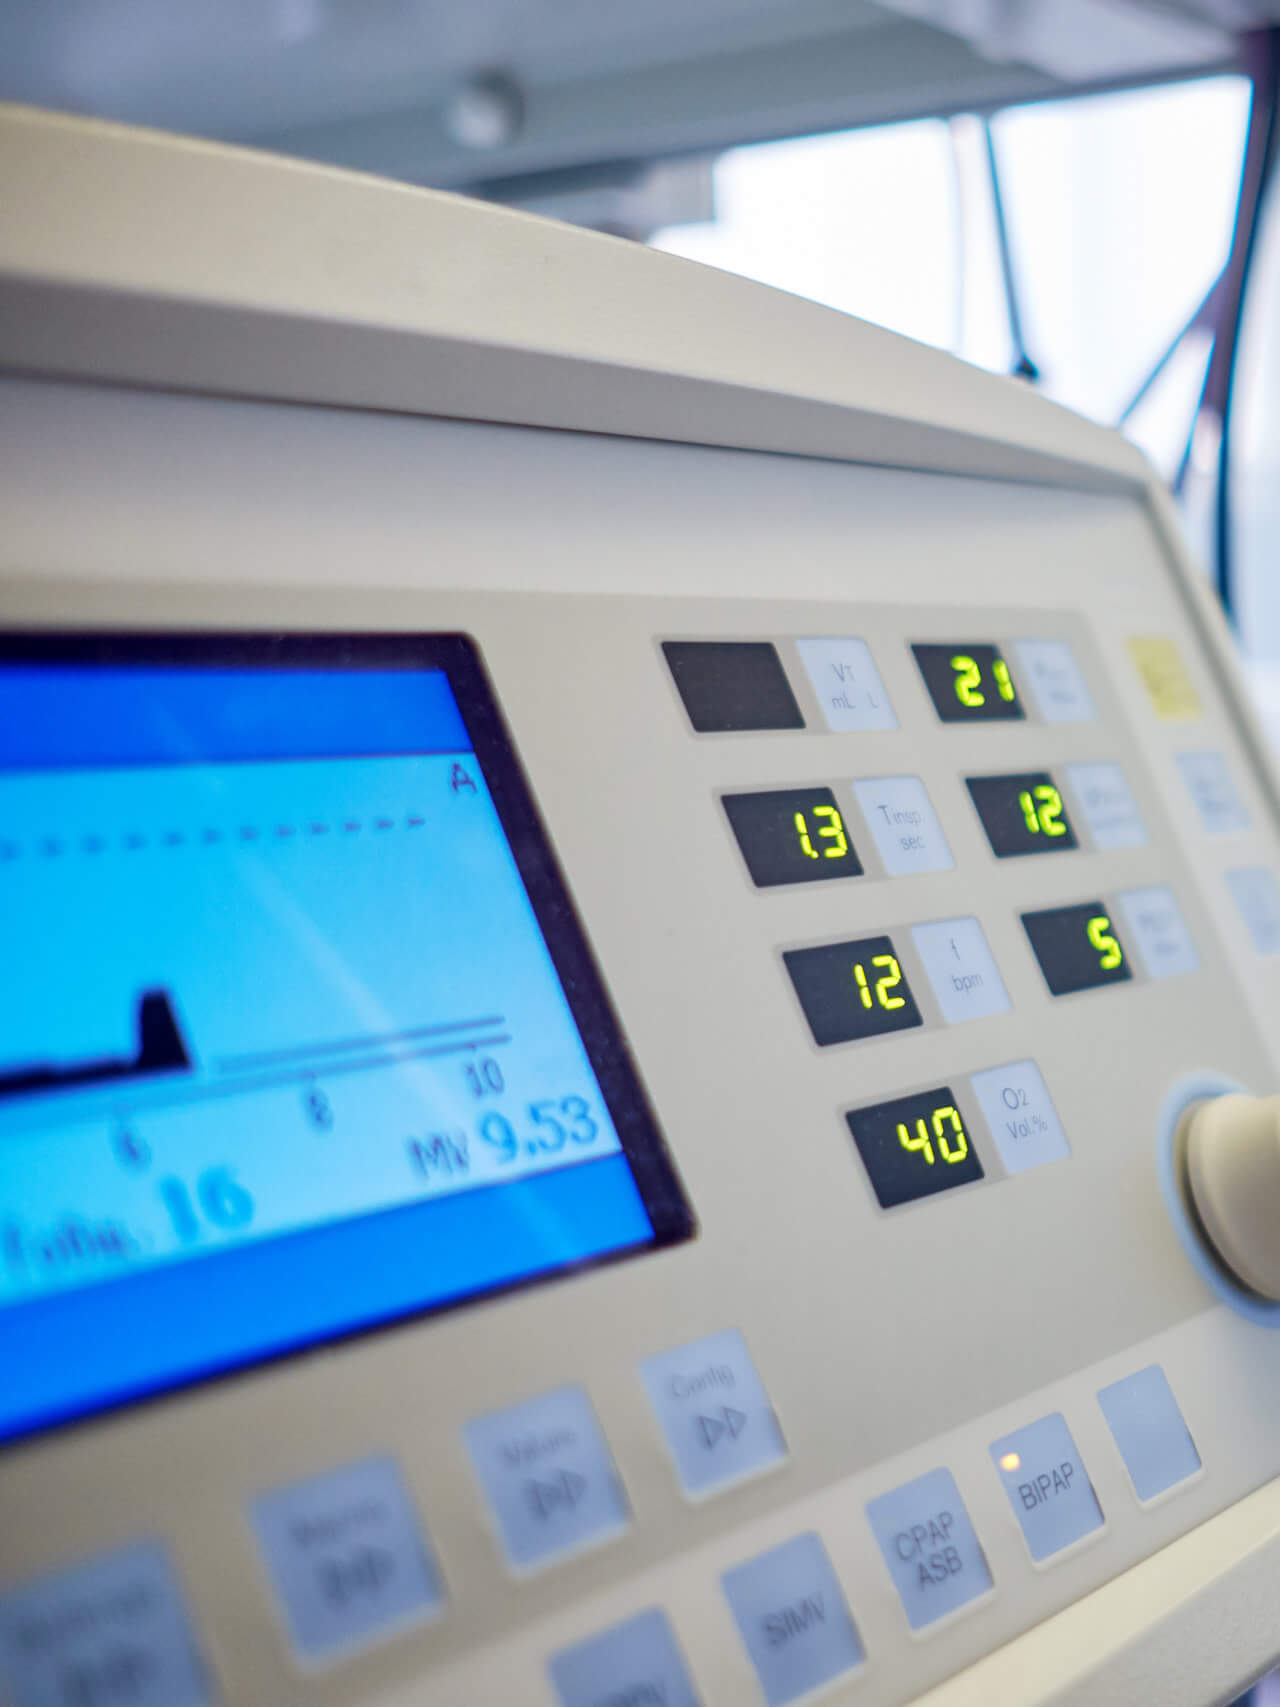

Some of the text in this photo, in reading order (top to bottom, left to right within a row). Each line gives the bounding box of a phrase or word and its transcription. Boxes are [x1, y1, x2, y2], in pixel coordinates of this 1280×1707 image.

[950, 655, 1015, 707] 21
[451, 762, 477, 793] A
[794, 805, 848, 859] 1.3
[1019, 785, 1067, 836] 12
[900, 834, 926, 852] sec
[1087, 916, 1122, 970] 5
[854, 955, 905, 1010] 12
[952, 972, 983, 993] bpm
[463, 1056, 504, 1098] 10
[407, 1095, 599, 1181] MV 9.53
[896, 1106, 968, 1164] 40
[160, 1163, 254, 1244] 16
[1017, 1461, 1075, 1511] BIPAP
[894, 1510, 954, 1562] CPAP
[915, 1546, 963, 1592] ASB
[760, 1590, 826, 1652] SIMV
